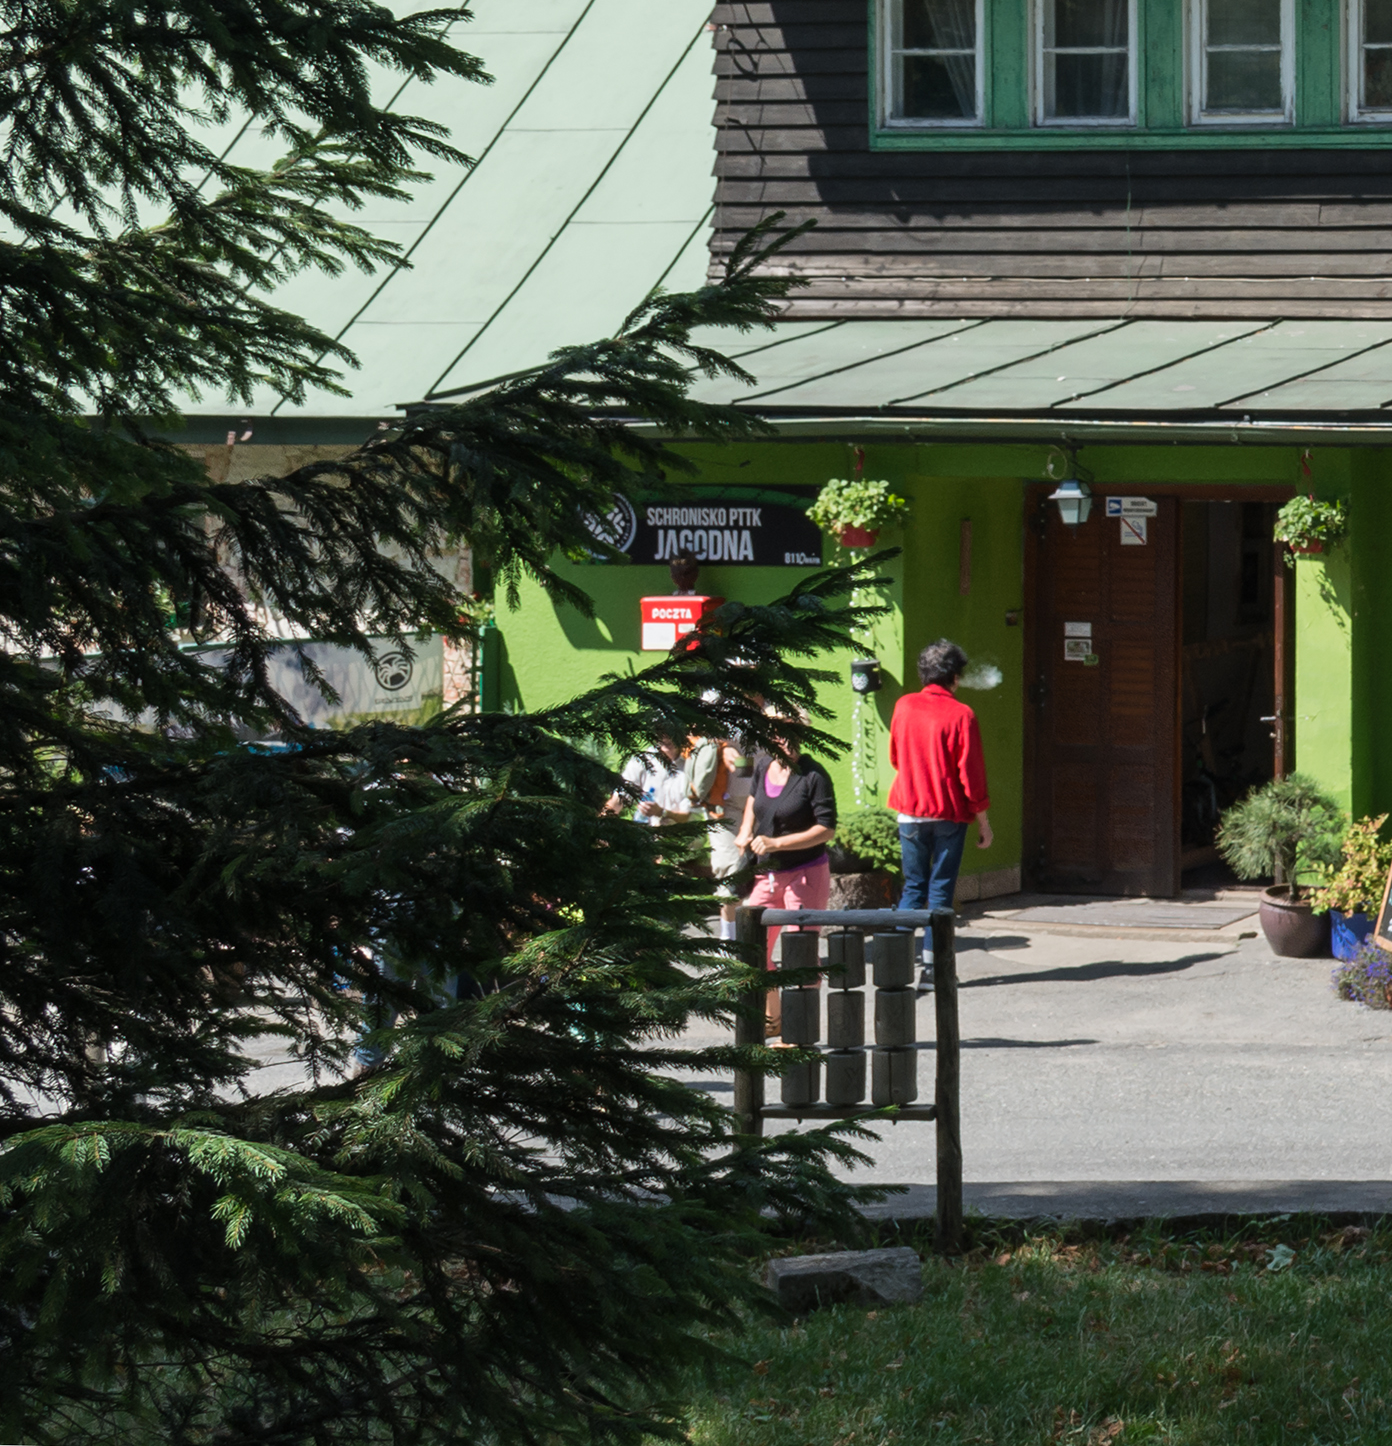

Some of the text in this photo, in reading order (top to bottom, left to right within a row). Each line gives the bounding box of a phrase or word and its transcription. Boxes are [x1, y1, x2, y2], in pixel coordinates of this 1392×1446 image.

[646, 507, 727, 527] SCHRONISKO
[729, 507, 762, 527] PTTK
[653, 528, 755, 561] JAGODNA
[651, 607, 693, 620] POCZTA
